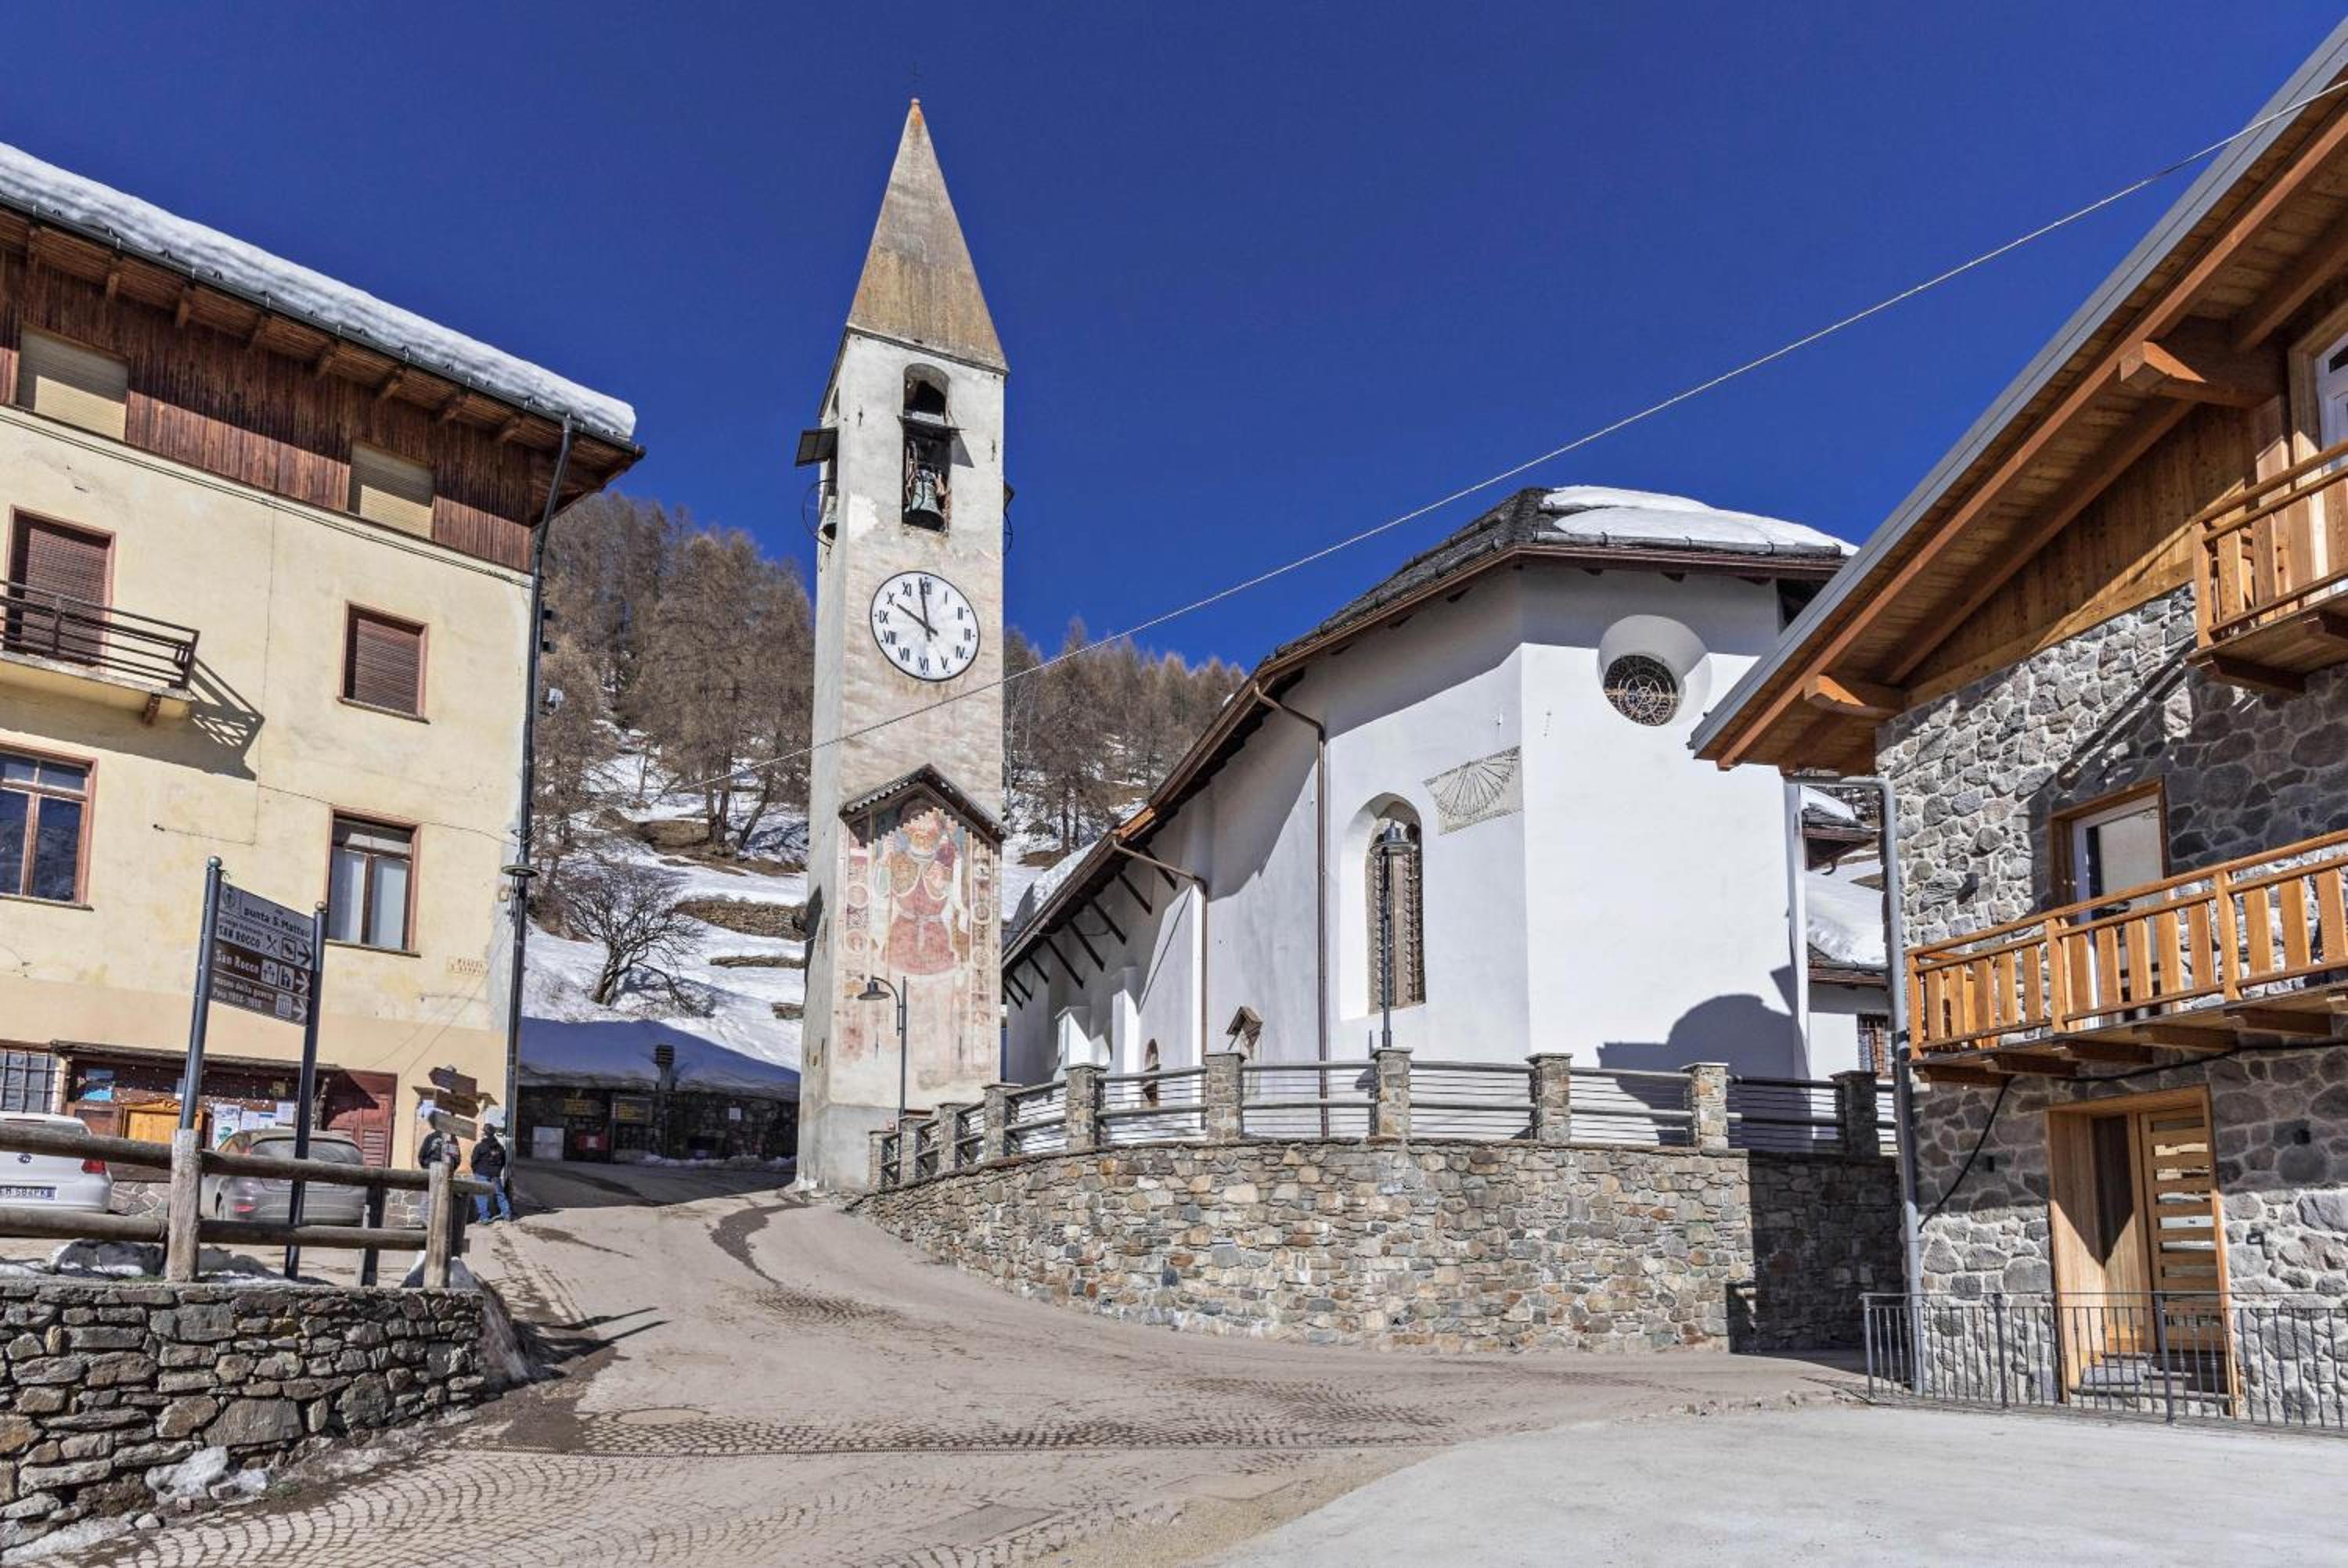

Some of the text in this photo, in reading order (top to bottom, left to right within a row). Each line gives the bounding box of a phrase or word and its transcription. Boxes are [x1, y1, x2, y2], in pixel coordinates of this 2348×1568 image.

[887, 591, 895, 606] X
[879, 610, 889, 624] IX
[957, 606, 963, 620] II
[918, 656, 929, 671] VI
[940, 656, 948, 670] V
[214, 948, 233, 965] San
